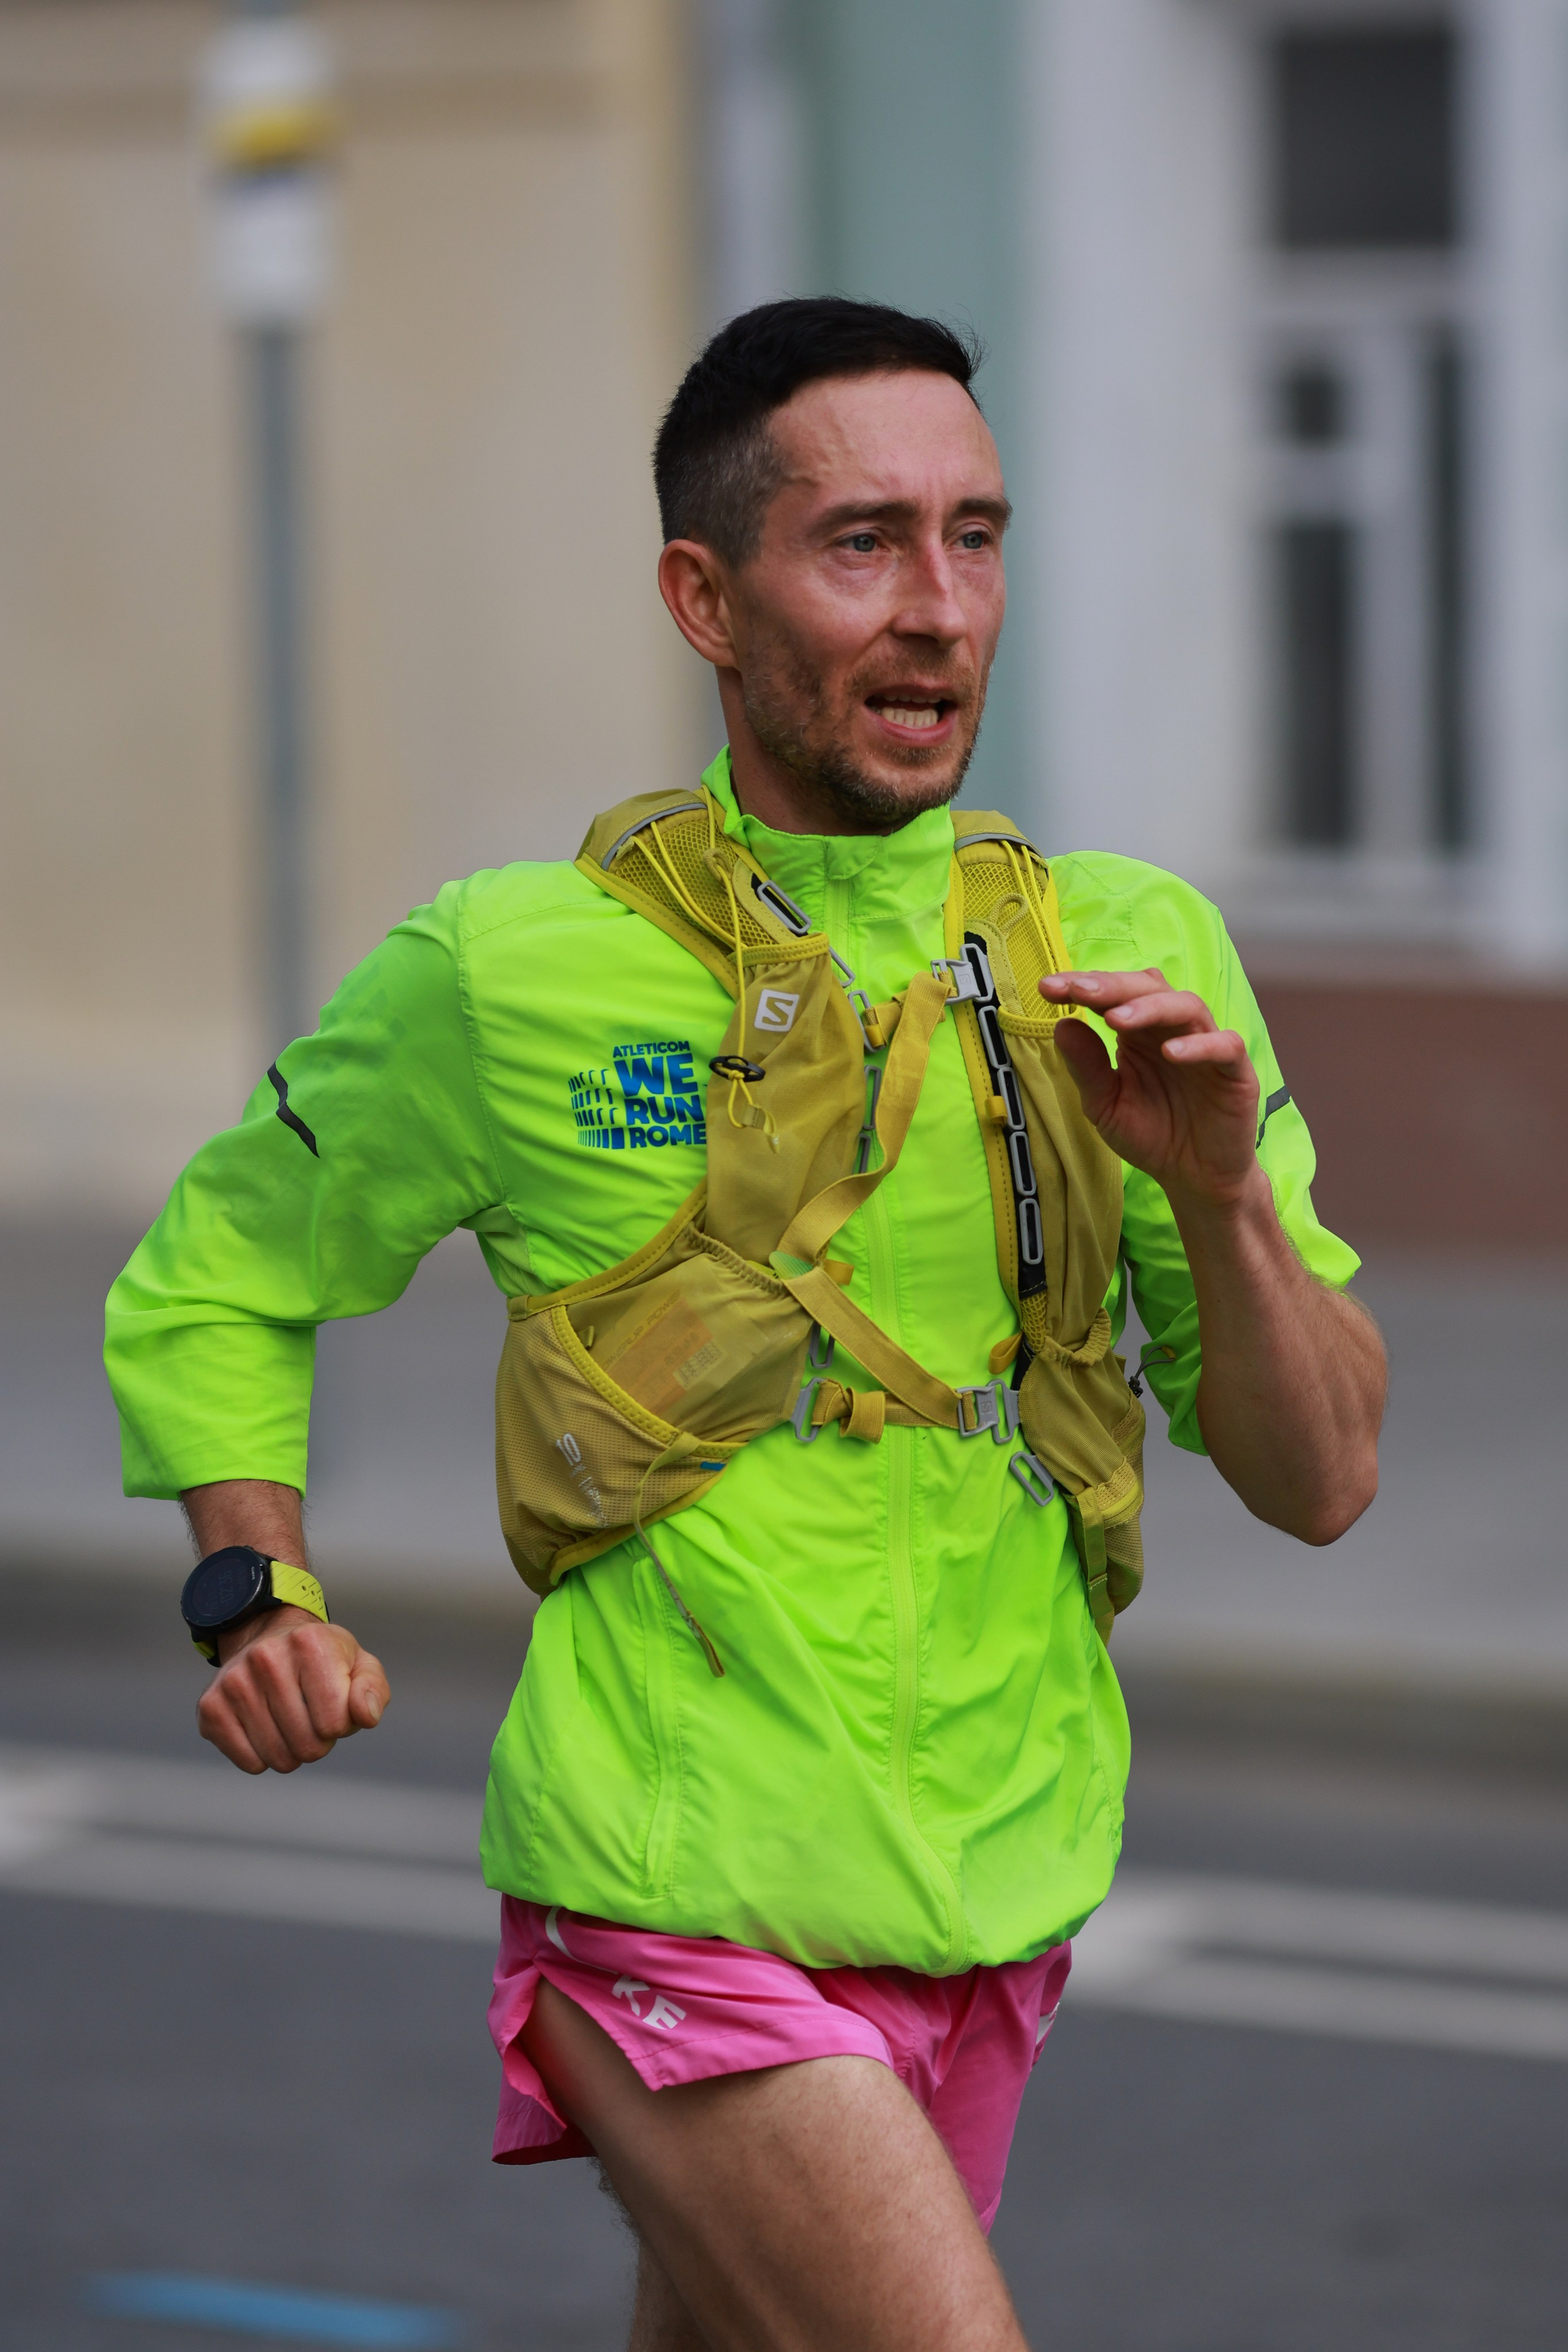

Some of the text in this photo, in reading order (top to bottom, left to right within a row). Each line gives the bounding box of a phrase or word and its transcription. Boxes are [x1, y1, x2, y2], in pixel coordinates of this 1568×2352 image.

[760, 995, 795, 1027] S
[612, 1041, 690, 1058] ATLETICOM
[614, 1053, 698, 1097] WE
[624, 1095, 704, 1126] RUN
[628, 1123, 707, 1148] ROME
[601, 1325, 644, 1371] OWERUP
[556, 1433, 581, 1466] 10
[611, 1973, 687, 2030] KE
